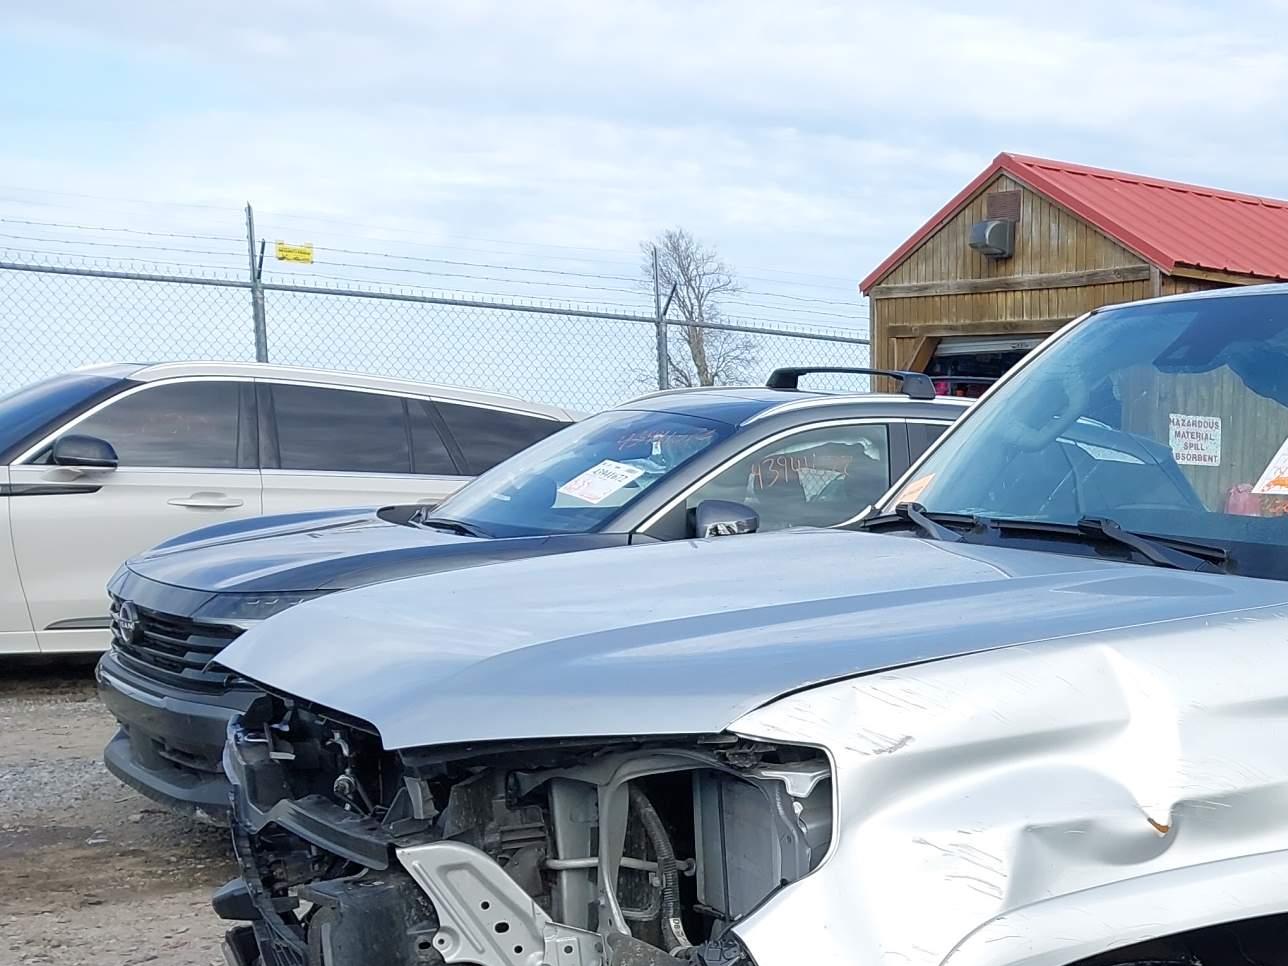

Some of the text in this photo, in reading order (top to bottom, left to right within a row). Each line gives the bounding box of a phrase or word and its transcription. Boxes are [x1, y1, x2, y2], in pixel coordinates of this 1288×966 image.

[1169, 417, 1220, 430] HAZARDOUS
[1174, 430, 1215, 441] MATERIAL
[1183, 441, 1206, 451] SPILL
[1175, 452, 1219, 463] BSORBENT
